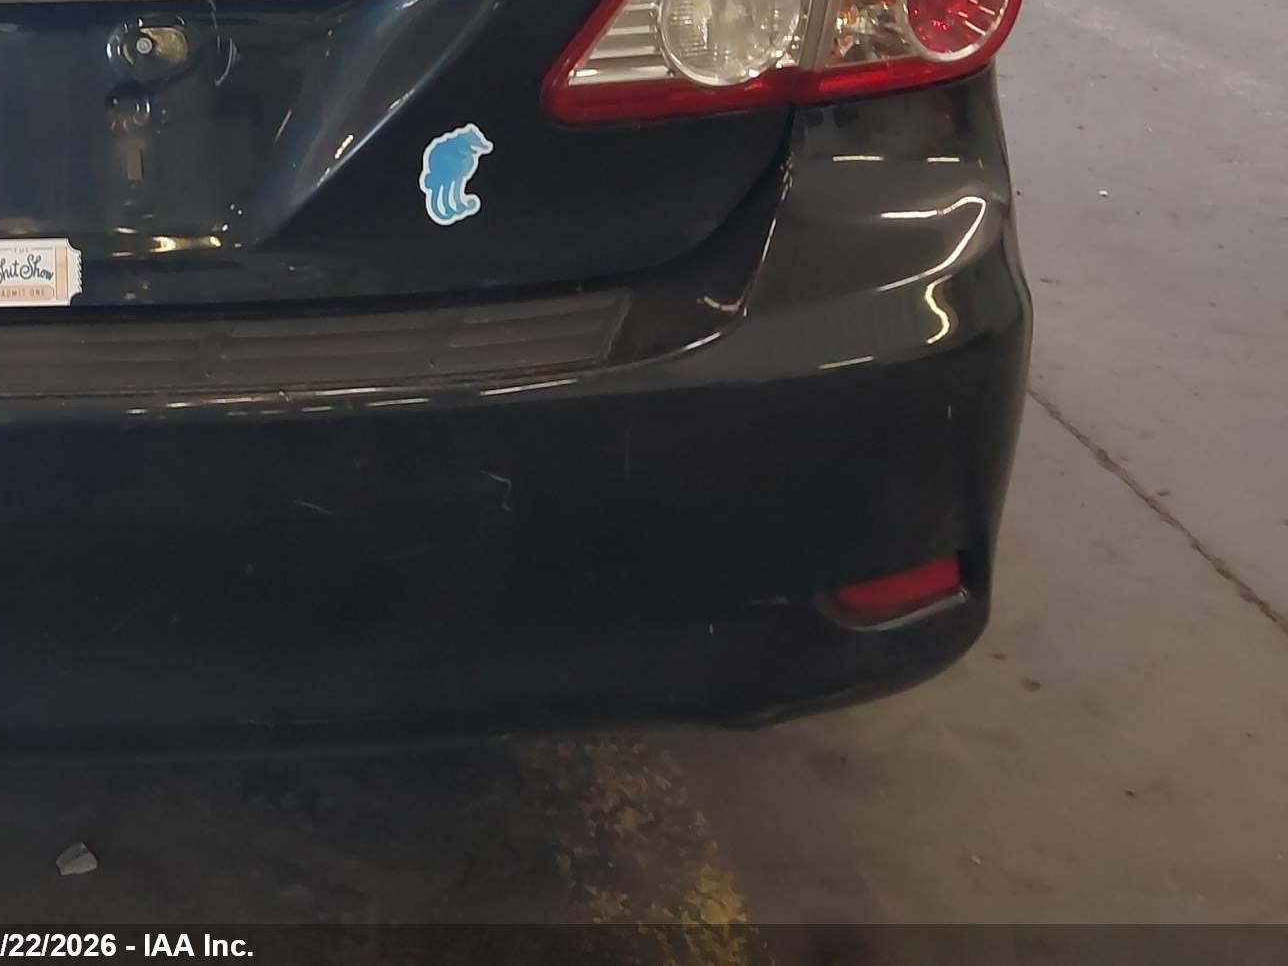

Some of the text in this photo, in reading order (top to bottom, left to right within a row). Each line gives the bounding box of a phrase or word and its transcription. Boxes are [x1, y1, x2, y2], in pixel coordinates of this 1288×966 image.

[19, 253, 55, 281] Show
[1, 288, 45, 299] ADMIT ONE
